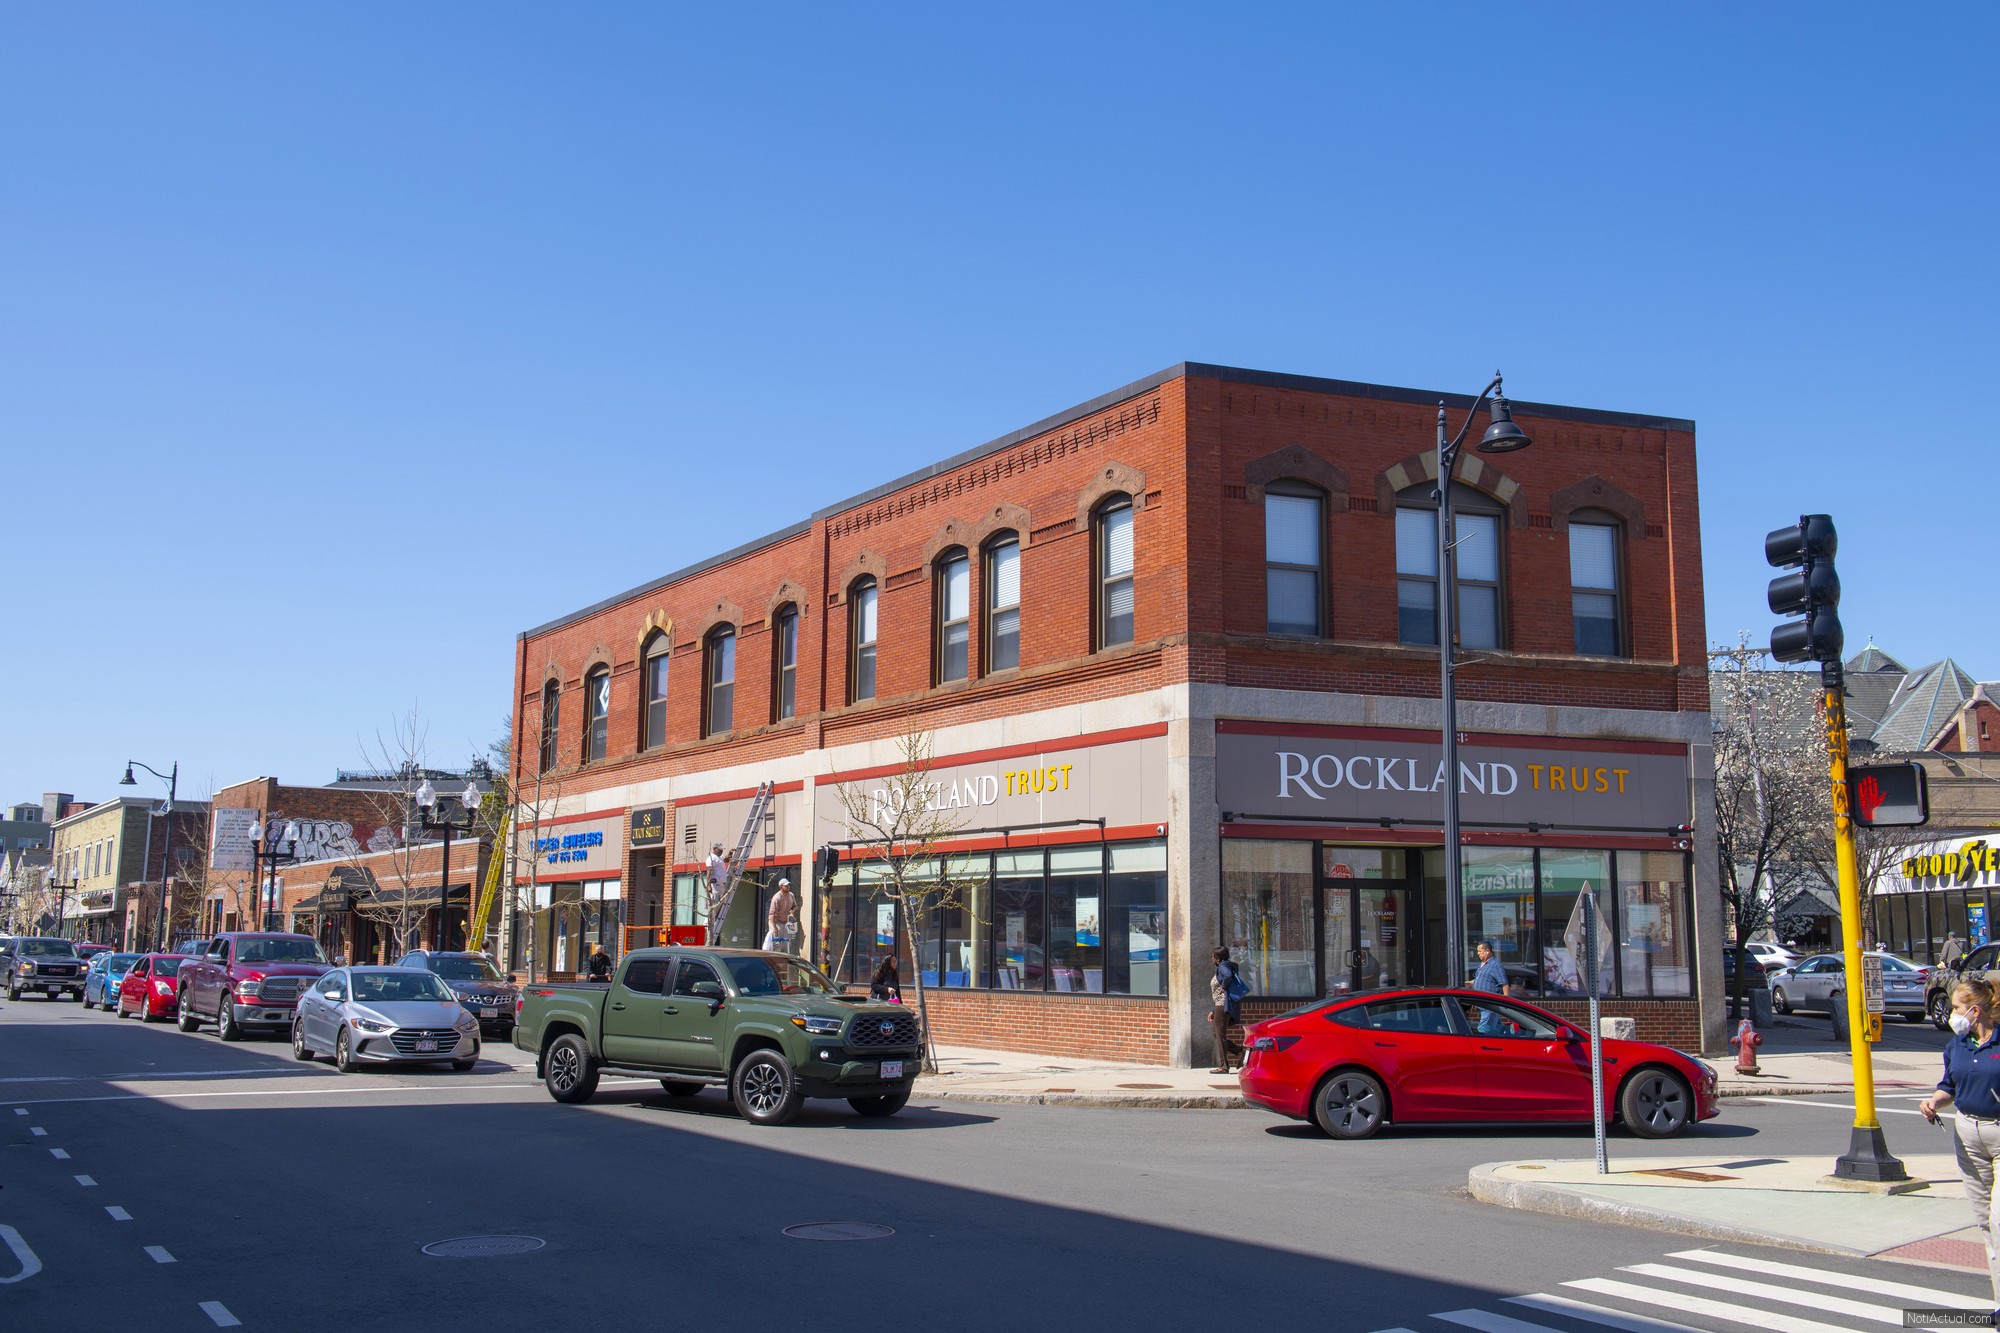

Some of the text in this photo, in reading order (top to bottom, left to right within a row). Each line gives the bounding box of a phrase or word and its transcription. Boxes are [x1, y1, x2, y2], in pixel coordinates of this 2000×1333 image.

[1005, 764, 1072, 796] TRUST
[1527, 764, 1629, 793] TRUST
[561, 832, 602, 848] JEWELERS
[1902, 847, 2000, 878] GOODYE
